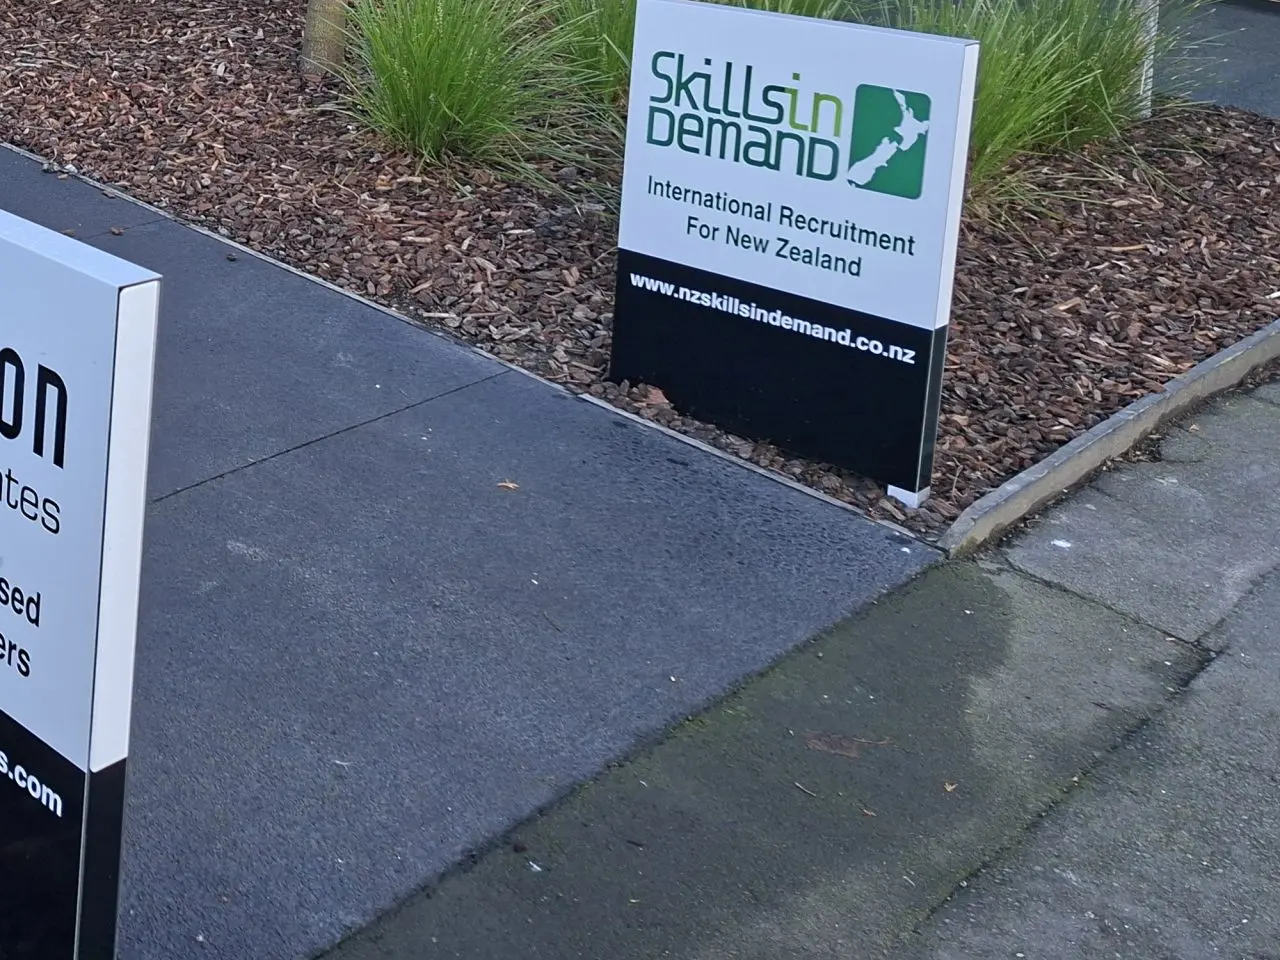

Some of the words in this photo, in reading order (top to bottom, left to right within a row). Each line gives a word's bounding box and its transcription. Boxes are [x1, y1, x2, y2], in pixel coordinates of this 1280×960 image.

[648, 175, 772, 222] International
[780, 206, 915, 256] Recruitment
[686, 216, 720, 240] For
[725, 227, 770, 253] New
[775, 238, 861, 277] Zealand
[630, 272, 916, 365] www.nzskillsindemand.co.nz
